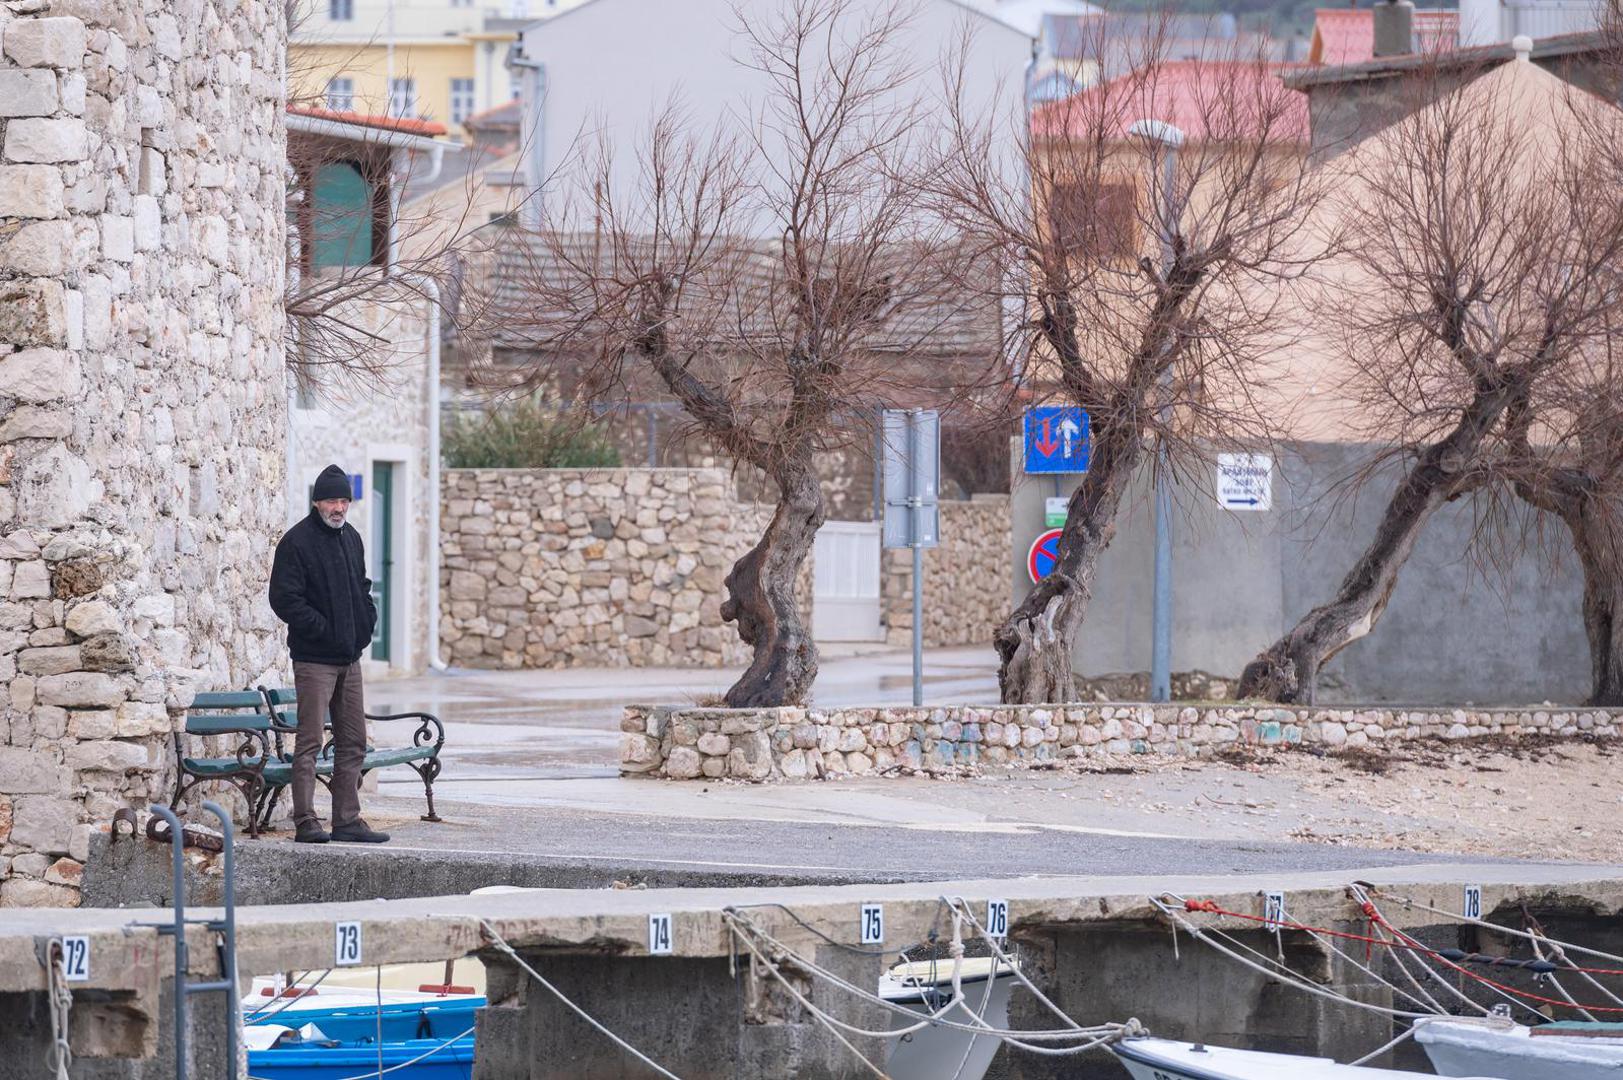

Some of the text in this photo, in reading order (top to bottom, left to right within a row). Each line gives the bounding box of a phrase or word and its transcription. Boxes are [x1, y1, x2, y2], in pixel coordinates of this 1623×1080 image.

[990, 903, 1006, 935] 76
[1466, 889, 1480, 918] 78
[652, 917, 669, 950] 74
[864, 908, 881, 940] 75
[65, 939, 86, 975] 72
[339, 925, 358, 960] 73
